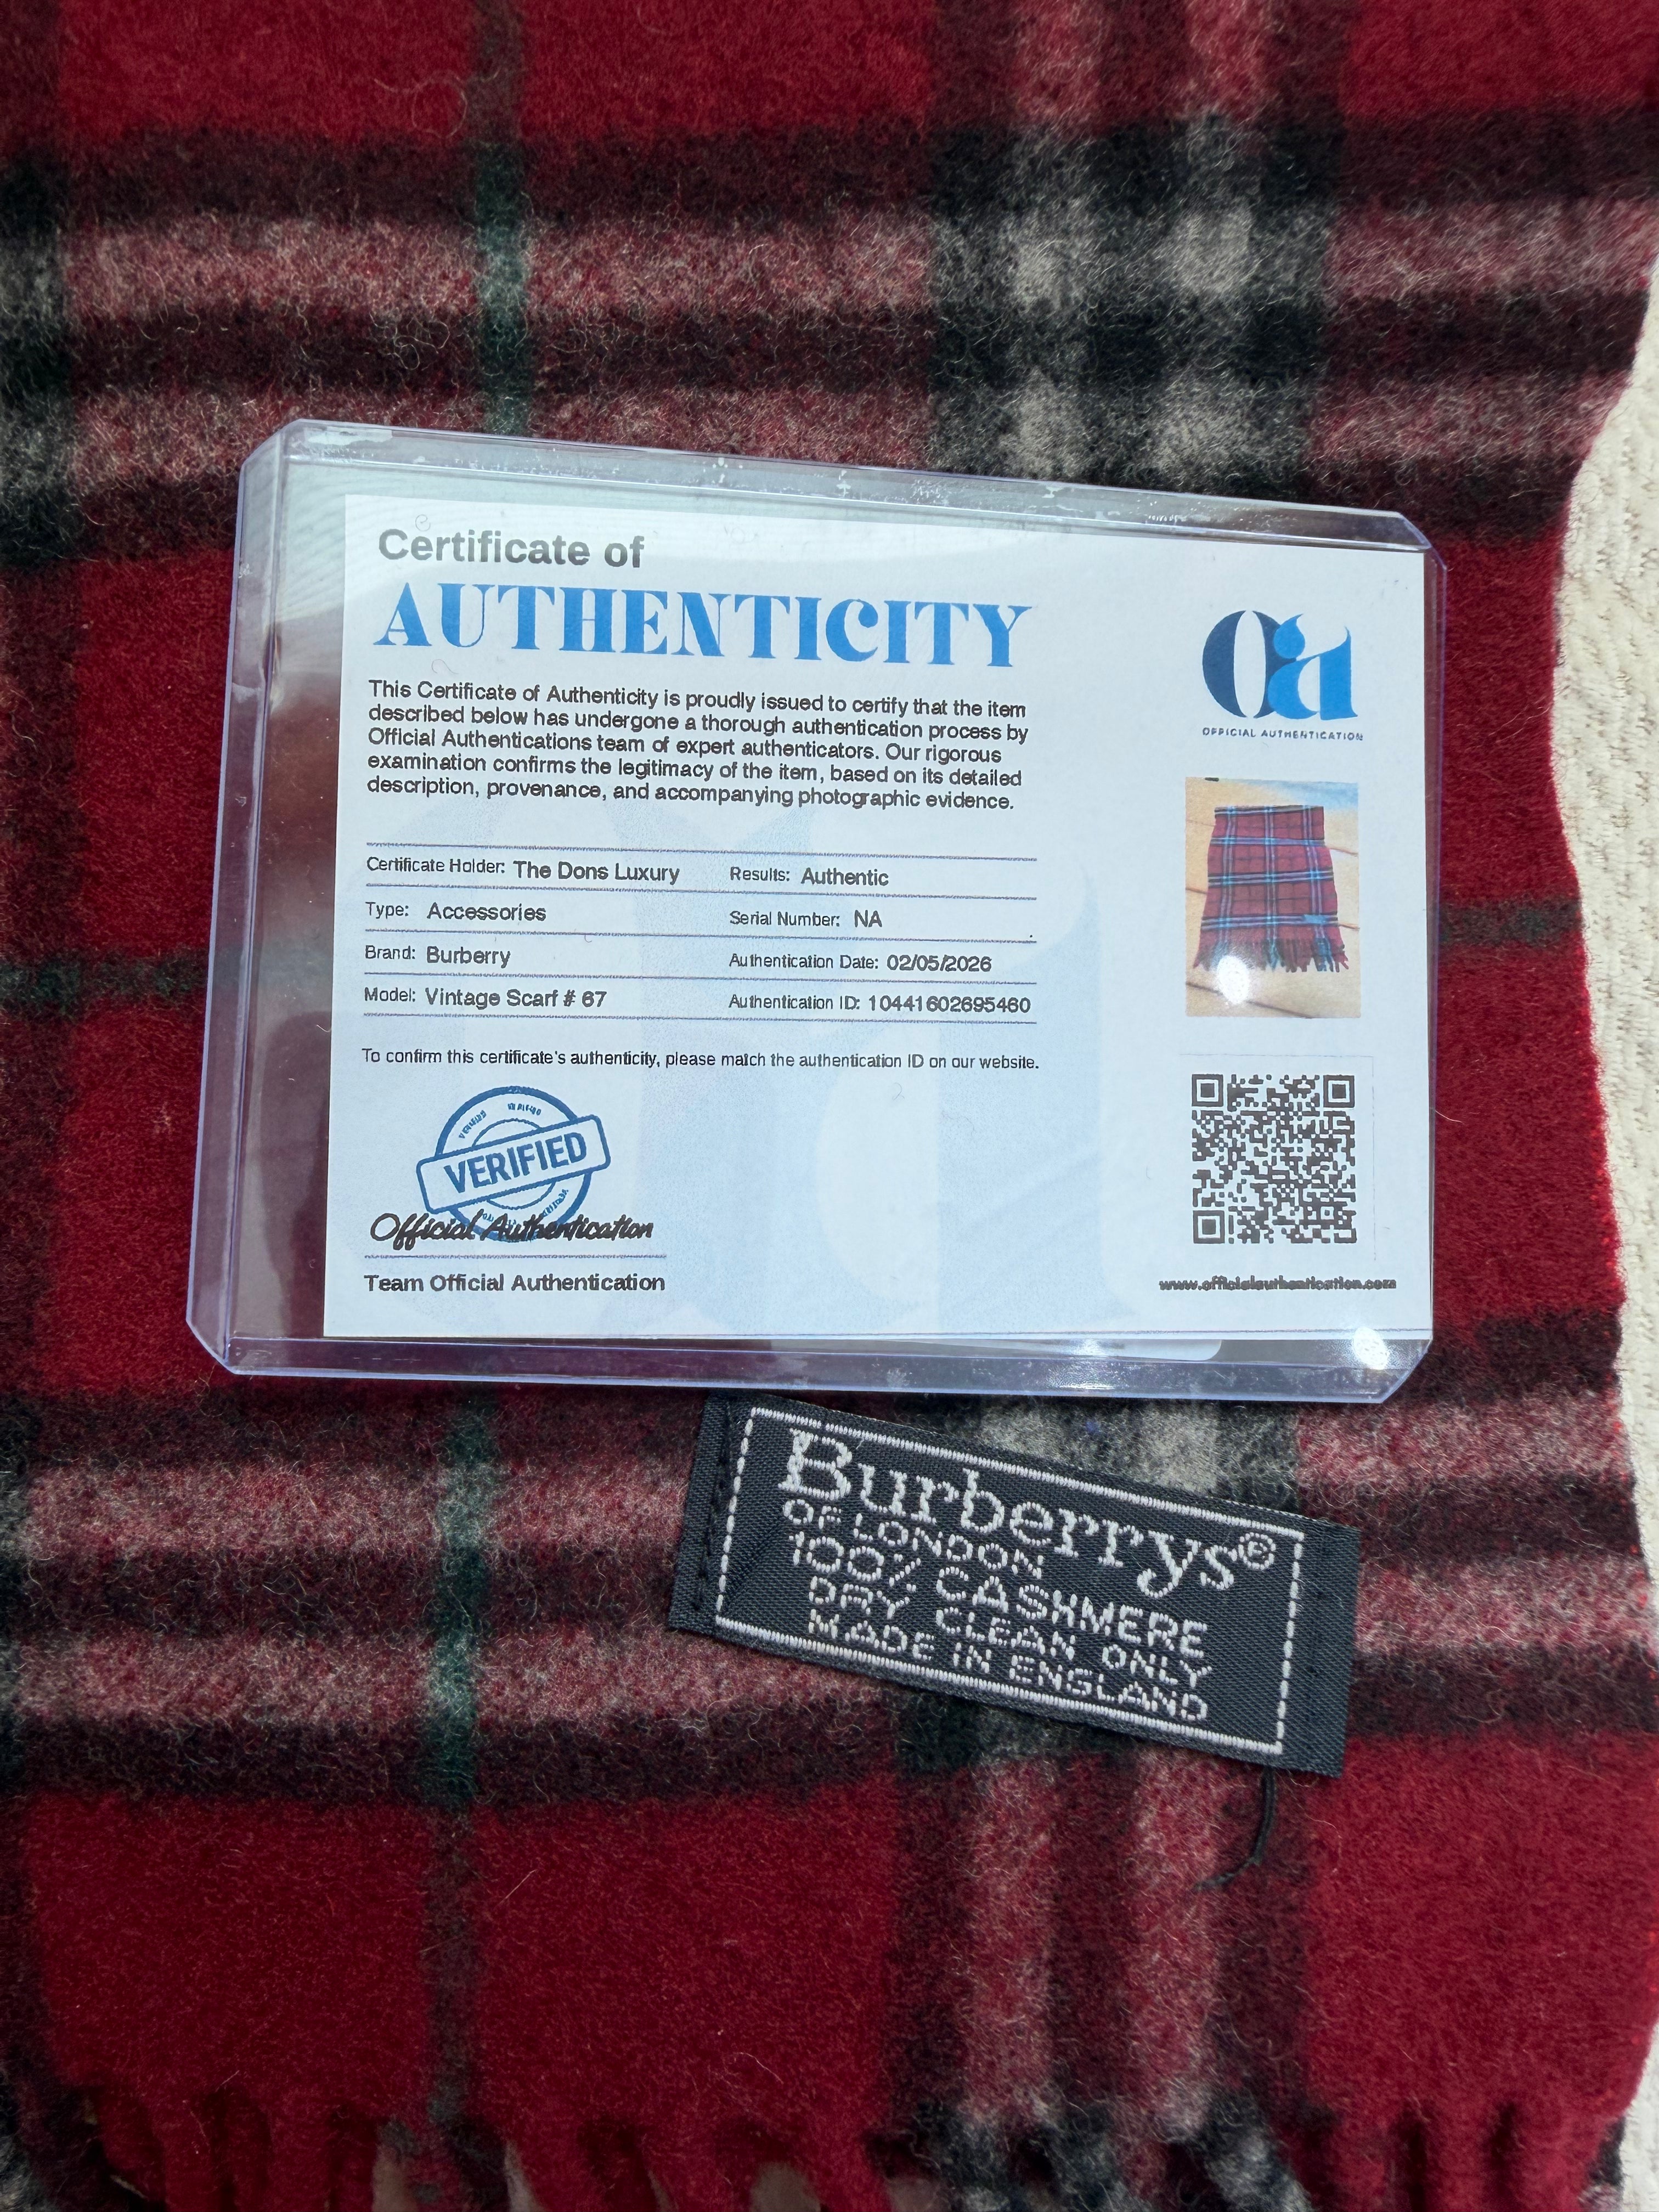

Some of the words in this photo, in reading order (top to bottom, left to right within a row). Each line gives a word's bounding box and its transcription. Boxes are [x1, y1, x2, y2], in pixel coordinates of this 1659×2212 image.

[379, 528, 590, 566] Certificate
[604, 535, 645, 568] of
[373, 582, 1032, 668] AUTHENTICITY
[368, 679, 412, 698] This
[417, 680, 517, 701] Certificate
[522, 684, 540, 702] of
[546, 685, 659, 710] Authenticity
[664, 689, 681, 707] is
[686, 691, 756, 713] proudly
[761, 692, 823, 712] issued
[828, 695, 847, 712] to
[852, 696, 909, 718] certify
[912, 698, 948, 715] that
[952, 698, 983, 716] the
[988, 700, 1026, 718] item
[369, 703, 465, 722] described
[469, 706, 528, 726] below
[533, 708, 569, 726] has
[574, 710, 679, 733] undergone
[685, 717, 697, 731] a
[701, 714, 786, 737] thorough
[792, 717, 923, 738] authentication
[928, 725, 1002, 742] process
[1007, 723, 1029, 746] by
[368, 727, 436, 747] Official
[441, 729, 592, 751] Authentications
[596, 734, 645, 753] team
[652, 736, 670, 753] of
[676, 738, 738, 755] expert
[741, 738, 879, 760] authenticators.
[885, 742, 921, 761] Our
[926, 744, 1002, 766] rigorous
[368, 752, 487, 772] examination
[493, 755, 577, 774] confirms
[580, 757, 612, 775] the
[618, 758, 714, 782] legitimacy
[719, 761, 738, 778] of
[742, 761, 773, 780] the
[779, 763, 824, 784] item,
[830, 764, 889, 783] based
[893, 770, 917, 783] on
[922, 767, 944, 785] its
[949, 768, 1022, 787] detailed
[366, 775, 479, 798] description,
[487, 782, 607, 801] provenance,
[613, 782, 650, 800] and
[654, 785, 794, 808] accompanying
[798, 787, 921, 810] photographic
[926, 791, 1014, 810] evidence.
[366, 856, 445, 872] Certificate
[449, 858, 505, 874] Holder:
[512, 860, 552, 879] The
[558, 861, 609, 881] Dons
[614, 862, 680, 885] Luxury
[730, 866, 790, 882] Results:
[800, 867, 889, 887] Authentic
[365, 901, 409, 919] Type:
[426, 901, 546, 922] Accessories
[729, 910, 772, 926] Serial
[777, 911, 840, 927] Number:
[854, 910, 883, 928] NA
[365, 945, 416, 960] Brand:
[426, 945, 511, 969] Burberry
[729, 953, 833, 969] Authentication
[839, 955, 879, 969] Date:
[887, 953, 992, 972] 02/05/2026
[364, 986, 416, 1002] Model:
[425, 987, 501, 1011] Vintage
[506, 989, 559, 1007] Scarf
[562, 989, 576, 1007] #
[582, 990, 607, 1008] 67
[728, 994, 833, 1010] Authentication
[840, 995, 860, 1011] ID:
[868, 995, 1031, 1013] 10441602695460
[361, 1048, 381, 1063] To
[386, 1048, 442, 1064] confirm
[447, 1048, 474, 1064] this
[480, 1049, 566, 1065] certificate's
[570, 1050, 660, 1069] authenticity,
[665, 1051, 716, 1069] please
[721, 1052, 766, 1067] match
[770, 1052, 795, 1067] the
[799, 1053, 901, 1068] authentication
[908, 1053, 924, 1068] ID
[929, 1057, 946, 1068] on
[951, 1057, 976, 1069] our
[979, 1054, 1039, 1069] website.
[443, 1132, 587, 1194] VERIFIED
[370, 1209, 484, 1251] Official
[479, 1213, 654, 1242] Authentication
[363, 1274, 424, 1292] Team
[430, 1273, 504, 1292] Official
[511, 1273, 665, 1292] Authentication
[782, 1498, 842, 1530] OF
[853, 1512, 1045, 1580] LONDON
[788, 1530, 922, 1592] 100%
[935, 1566, 1208, 1659] CASHMERE
[808, 1575, 911, 1620] DRY
[935, 1606, 1076, 1661] CLEAN
[1101, 1644, 1212, 1689] ONLY
[808, 1609, 935, 1661] MADE
[952, 1641, 992, 1675] IN
[1008, 1654, 1208, 1722] ENGLAND
